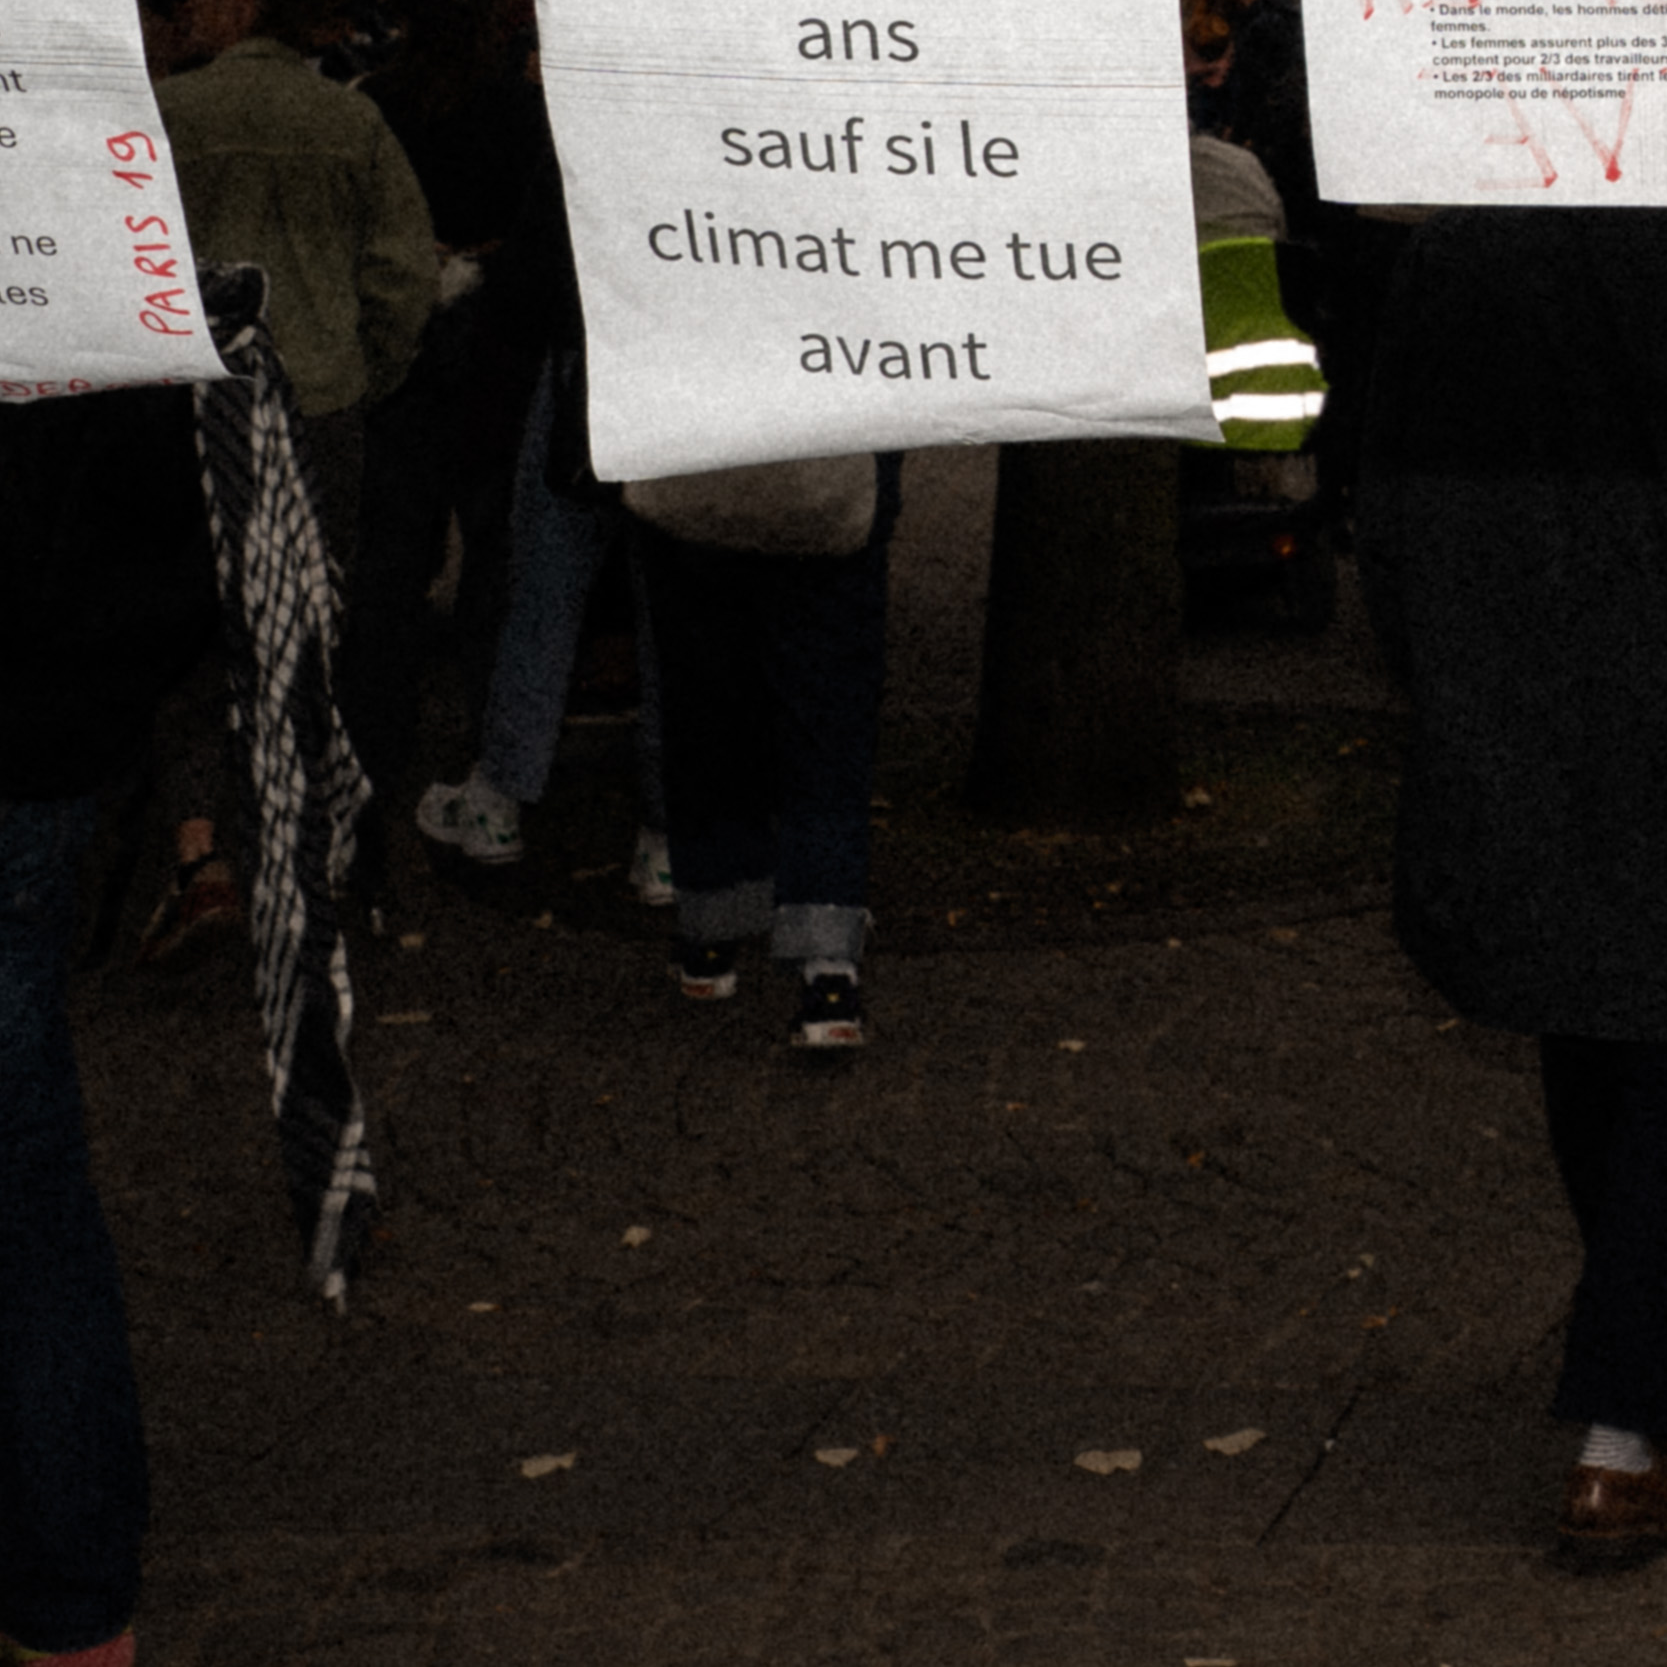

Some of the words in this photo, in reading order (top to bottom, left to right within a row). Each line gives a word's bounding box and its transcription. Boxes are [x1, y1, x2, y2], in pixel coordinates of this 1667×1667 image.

[1439, 2, 1475, 15] Dans
[1479, 2, 1491, 15] le
[1496, 2, 1548, 18] monde,
[1552, 2, 1573, 15] les
[1577, 2, 1638, 15] hommes
[1430, 19, 1489, 32] femmes.
[799, 19, 918, 62] ans
[1441, 36, 1466, 49] Les
[1470, 35, 1526, 48] femmes
[1531, 35, 1592, 48] assurent
[1596, 35, 1627, 50] plus
[1631, 35, 1657, 48] des
[1432, 52, 1499, 68] comptent
[1503, 55, 1536, 67] pour
[1540, 52, 1560, 65] 2/3
[1565, 52, 1590, 65] des
[1443, 69, 1468, 82] Les
[1473, 69, 1493, 82] 2/3
[1497, 69, 1522, 82] des
[1526, 68, 1613, 81] milliardaires
[1617, 68, 1654, 81] tirent
[1434, 86, 1505, 101] monopole
[1508, 89, 1527, 99] ou
[1530, 86, 1548, 99] de
[1552, 86, 1626, 101] népotisme
[105, 131, 157, 190] 19
[722, 117, 863, 173] sauf
[887, 121, 934, 174] si
[961, 120, 1018, 177] le
[649, 209, 859, 276] climat
[881, 241, 985, 279] me
[1006, 233, 1121, 280] tue
[126, 215, 193, 337] PARIS
[801, 333, 990, 380] avant
